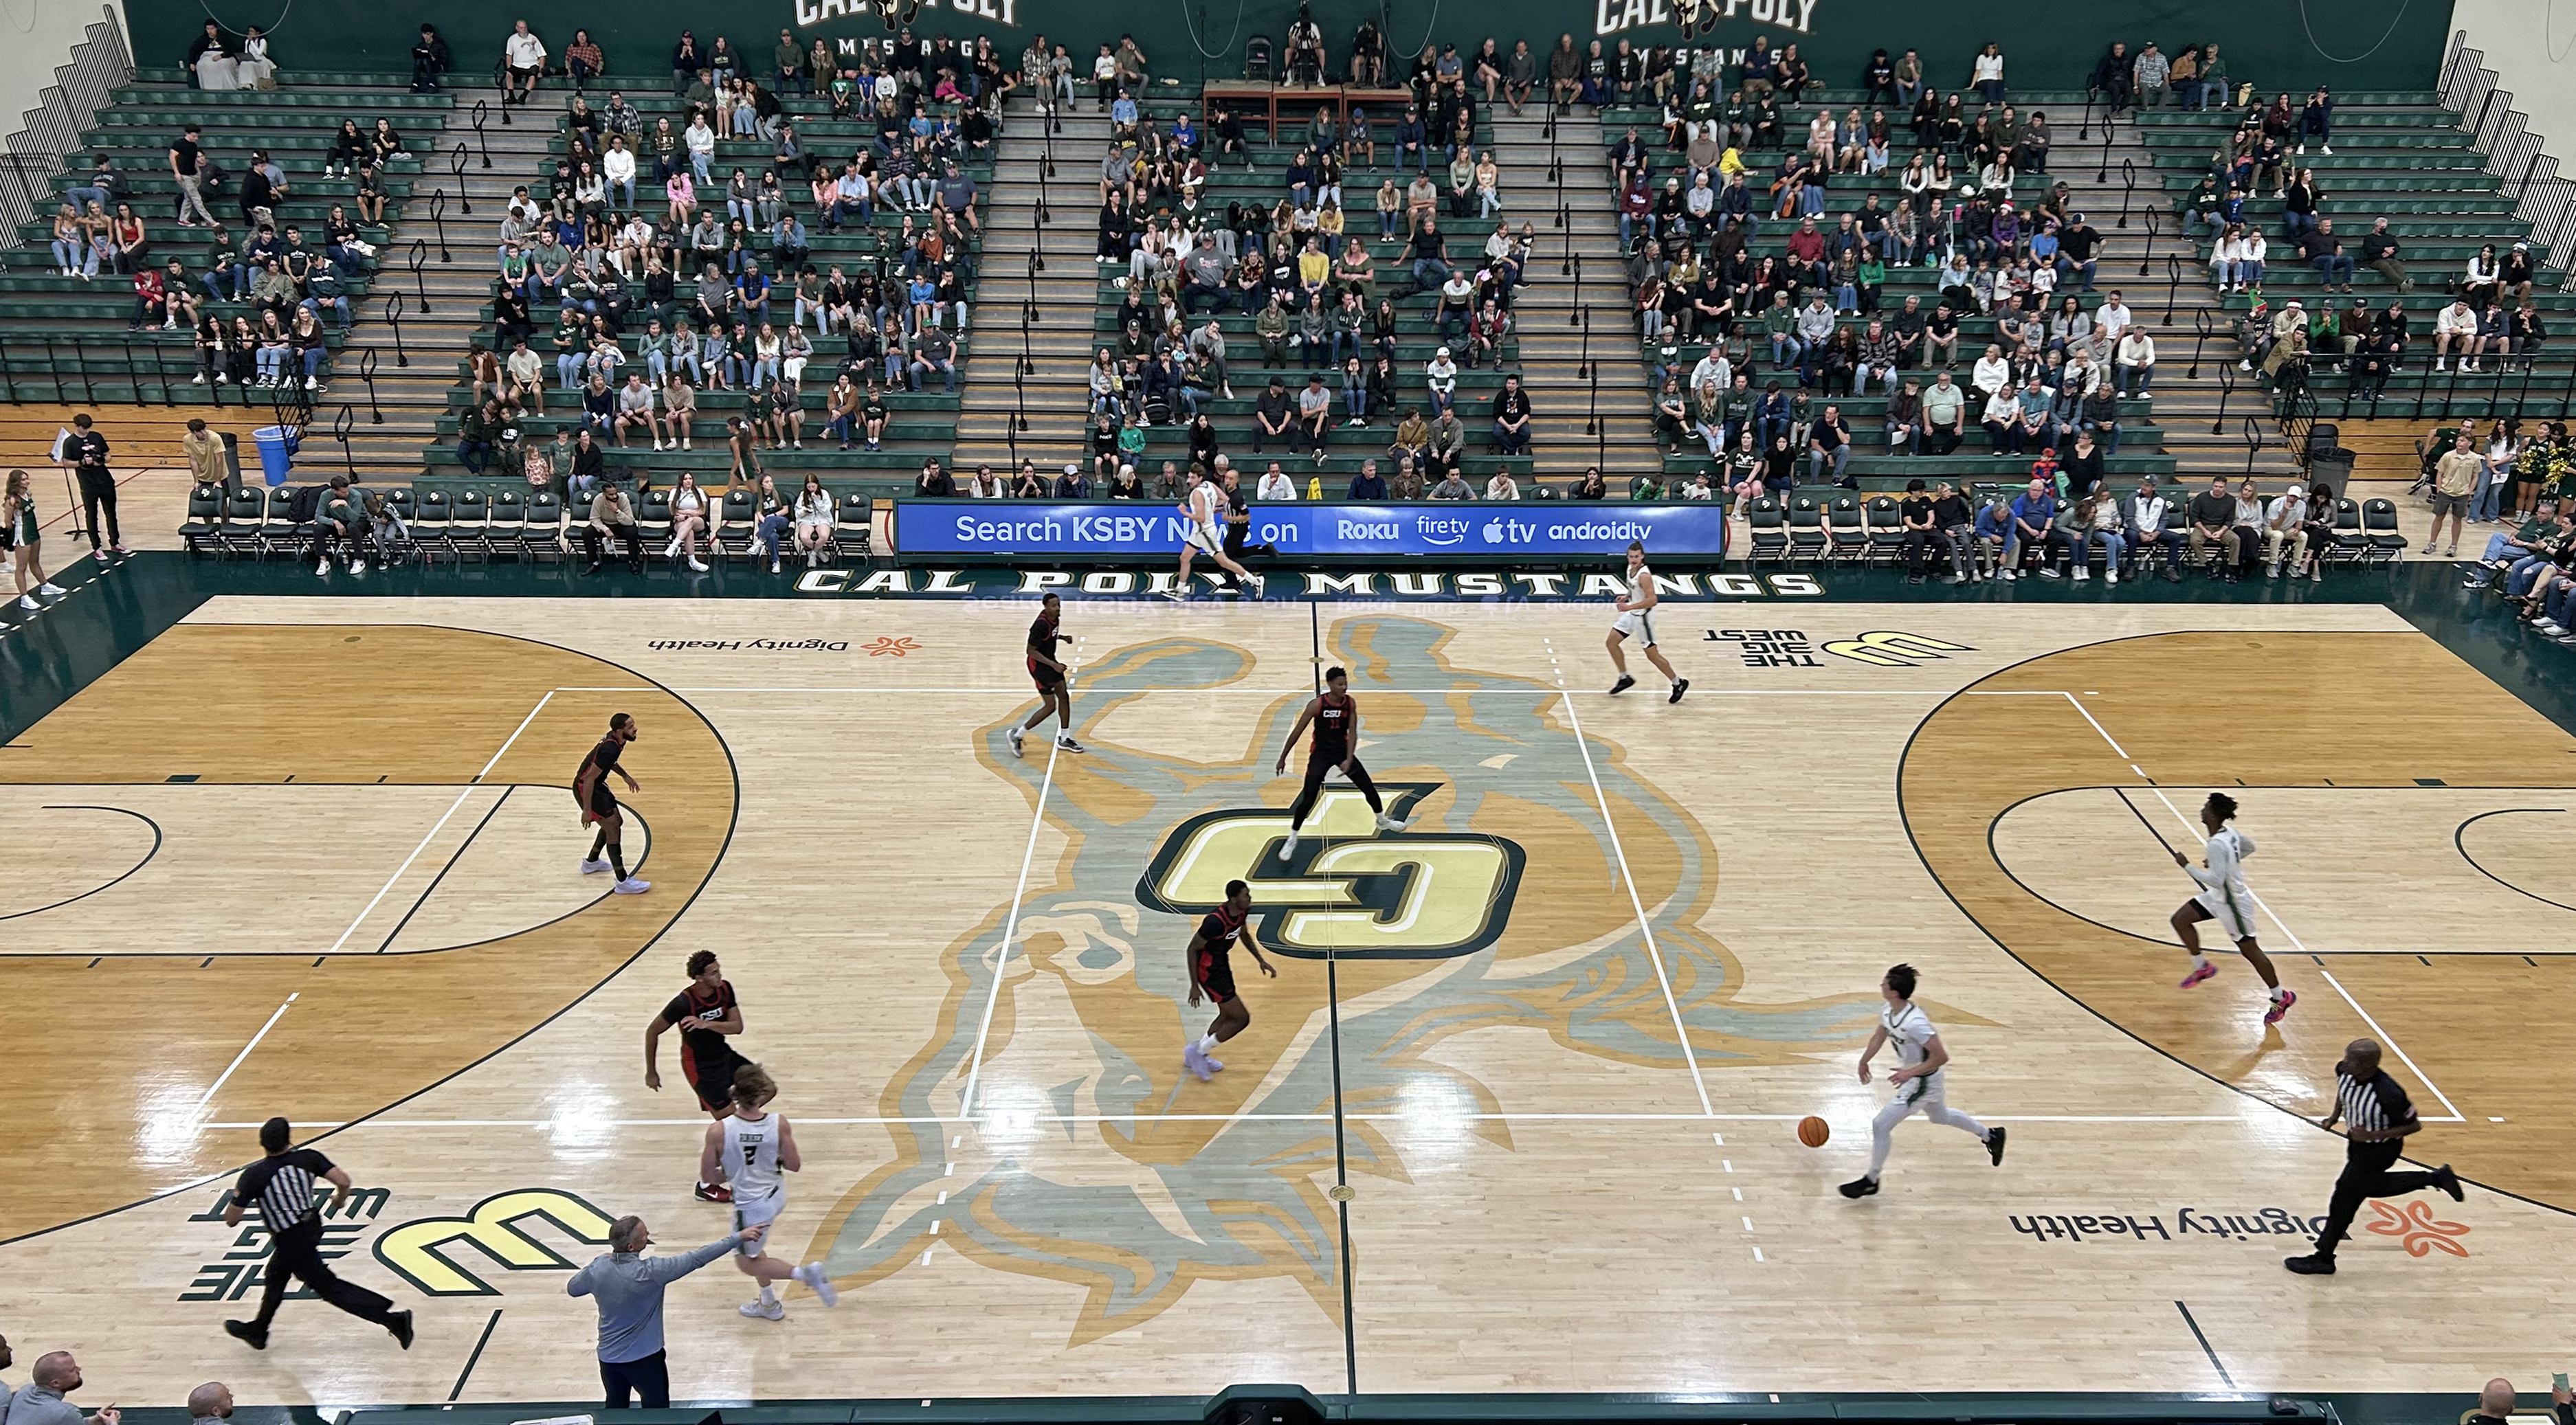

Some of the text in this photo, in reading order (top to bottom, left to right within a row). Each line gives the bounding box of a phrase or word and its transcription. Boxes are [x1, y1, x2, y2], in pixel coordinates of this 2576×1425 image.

[794, 0, 867, 27] CA
[1632, 49, 1783, 65] MSANS
[956, 515, 1061, 541] Search
[1072, 517, 1159, 541] KSBY
[1261, 524, 1298, 542] on
[1507, 519, 1536, 543] tv
[794, 569, 1826, 596] CAL POLY MUSTANGS
[647, 638, 850, 652] Dignity Health
[1702, 630, 1809, 642] WEST
[1740, 642, 1814, 654] BIG
[1740, 655, 1825, 667] THE
[2008, 1214, 2171, 1242] Health
